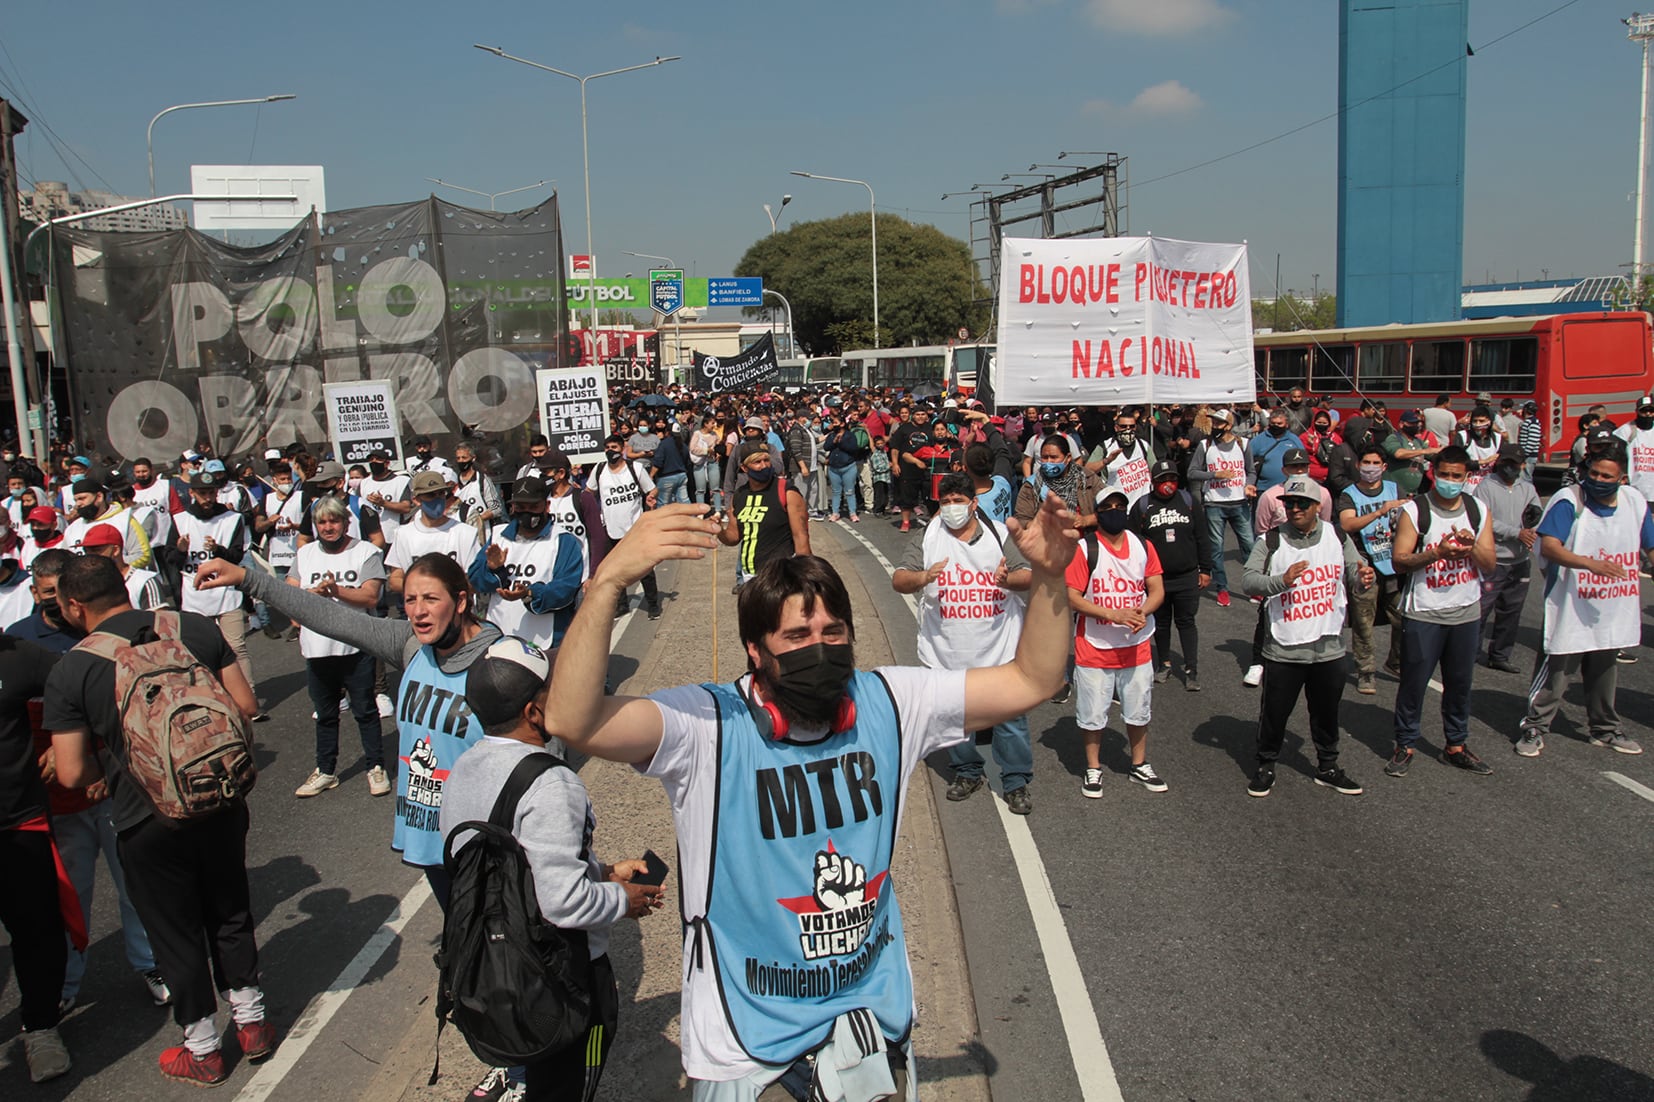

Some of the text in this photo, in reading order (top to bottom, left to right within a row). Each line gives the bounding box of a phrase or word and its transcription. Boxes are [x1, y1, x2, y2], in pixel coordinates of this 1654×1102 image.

[1019, 261, 1237, 309] BLOQUE PIQUETERO
[171, 257, 446, 369] POLO
[1072, 335, 1201, 379] NACIONAL
[549, 377, 597, 392] ABAJO
[336, 394, 384, 405] TRABAJO
[550, 389, 598, 400] EL AJUSTE
[338, 403, 385, 414] GENUINO
[549, 401, 601, 419] FUERA
[337, 415, 342, 423] Y
[343, 414, 361, 422] OBRA
[550, 415, 602, 432] EL FMI
[558, 440, 598, 451] OBRERO
[563, 433, 591, 443] POLO
[352, 442, 384, 452] POLO
[610, 482, 636, 496] POLO
[737, 506, 769, 523] 46
[1160, 508, 1177, 516] Los
[1148, 512, 1190, 530] Angeles
[937, 569, 996, 587] BLOQU
[940, 604, 1005, 619] NACIONAL
[400, 680, 473, 739] MTR
[756, 751, 883, 840] MTR
[800, 898, 877, 932] VOTAMOS
[745, 958, 830, 998] Movimiento
